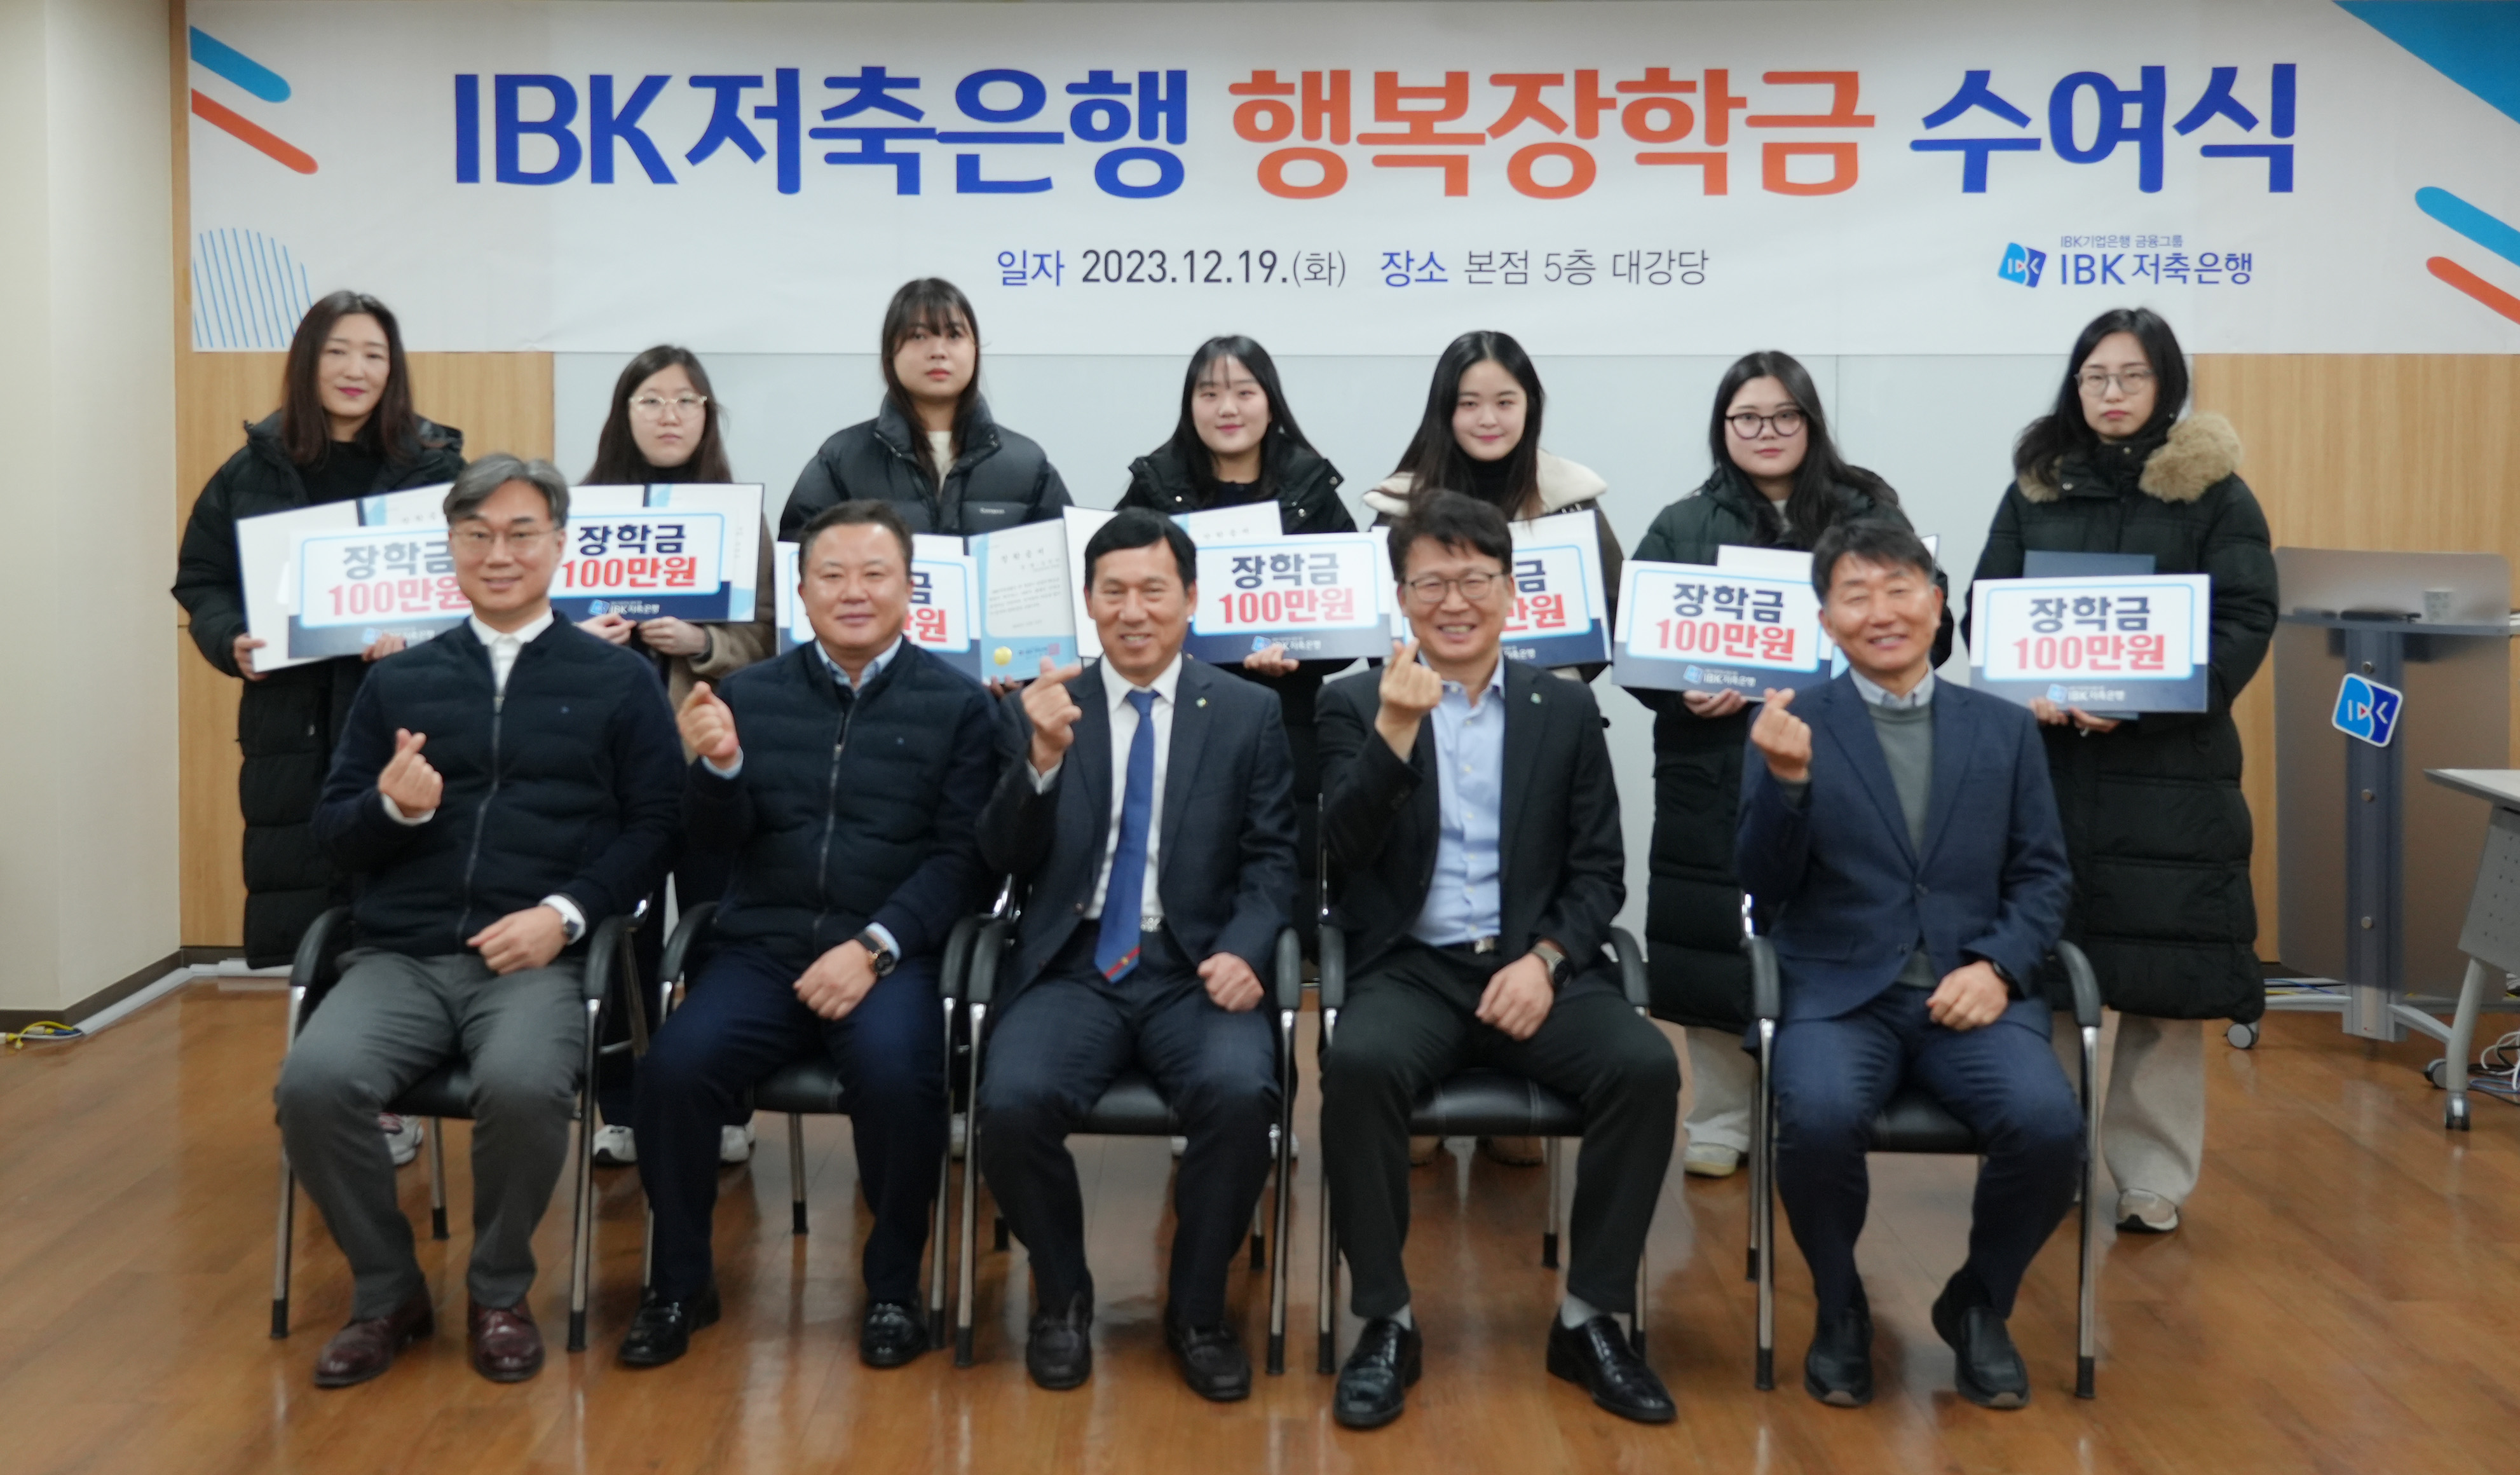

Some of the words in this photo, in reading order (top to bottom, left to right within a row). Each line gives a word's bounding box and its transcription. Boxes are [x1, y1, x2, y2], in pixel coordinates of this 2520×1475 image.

[454, 66, 1187, 198] IBK저축은행
[1229, 66, 1875, 199] 행복장학금
[1910, 63, 2296, 193] 수여식
[2061, 235, 2130, 248] IBK기업은행
[2135, 235, 2183, 248] 금융그룹
[998, 250, 1065, 286] 일자
[1082, 250, 1345, 287] 2023.12.19.(화)
[1381, 250, 1448, 287] 장소
[1464, 250, 1527, 284] 본점
[1545, 250, 1596, 285] 5층
[1613, 250, 1708, 285] 대강당
[578, 525, 685, 556] 장학금
[343, 541, 456, 580] 장학금
[562, 557, 696, 587] 100만원
[1232, 553, 1339, 589] 장학금
[1219, 588, 1354, 623] 100만원
[1673, 583, 1783, 623] 장학금
[2030, 596, 2150, 633] 장학금
[1656, 619, 1794, 661] 100만원
[2013, 635, 2164, 670] 100만원
